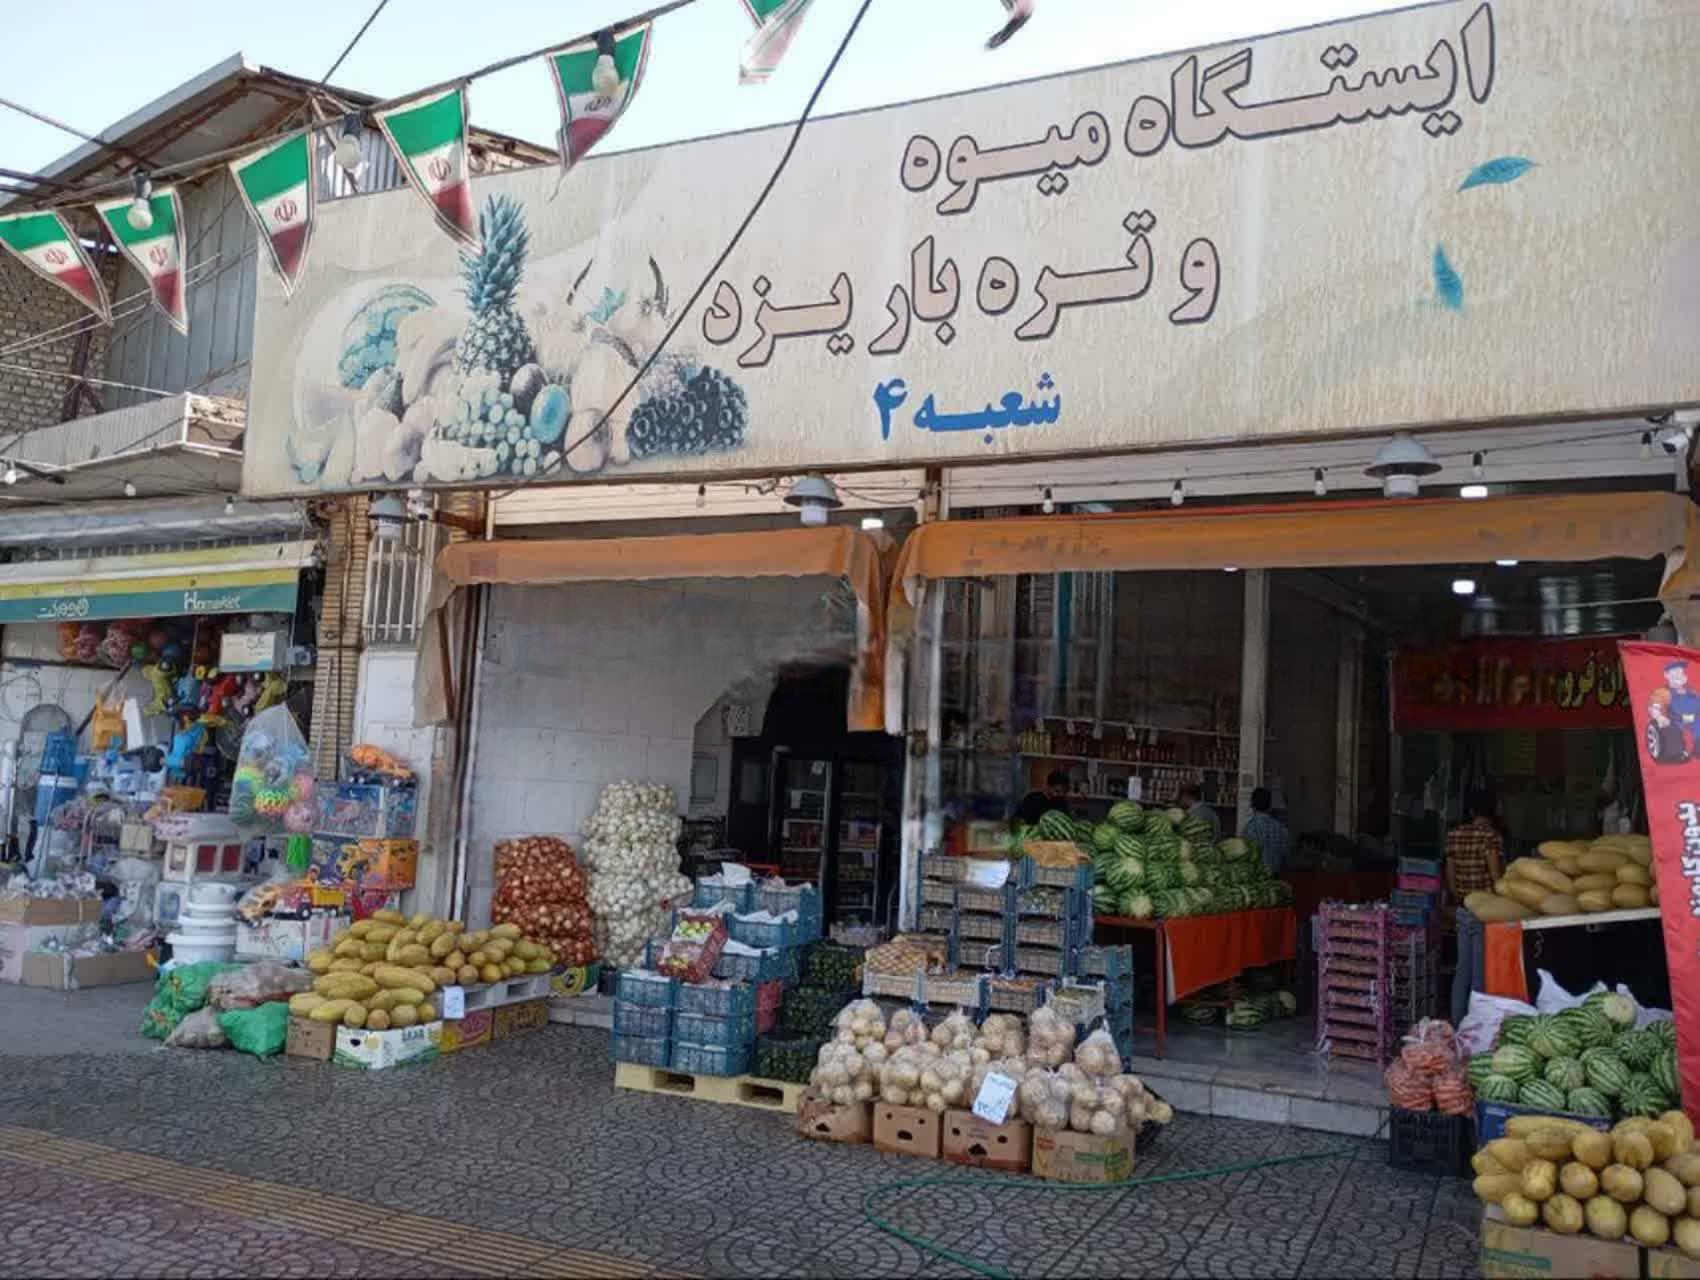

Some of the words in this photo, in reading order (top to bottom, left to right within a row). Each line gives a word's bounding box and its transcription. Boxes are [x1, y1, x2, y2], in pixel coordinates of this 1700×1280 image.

[1124, 2, 1496, 158] ایستگاه
[901, 111, 1111, 215] میوه
[702, 271, 855, 370] یزد
[868, 235, 961, 357] بار
[976, 209, 1156, 341] تره
[1169, 237, 1220, 325] و
[872, 377, 908, 441] ۴
[913, 373, 1062, 444] شعبه
